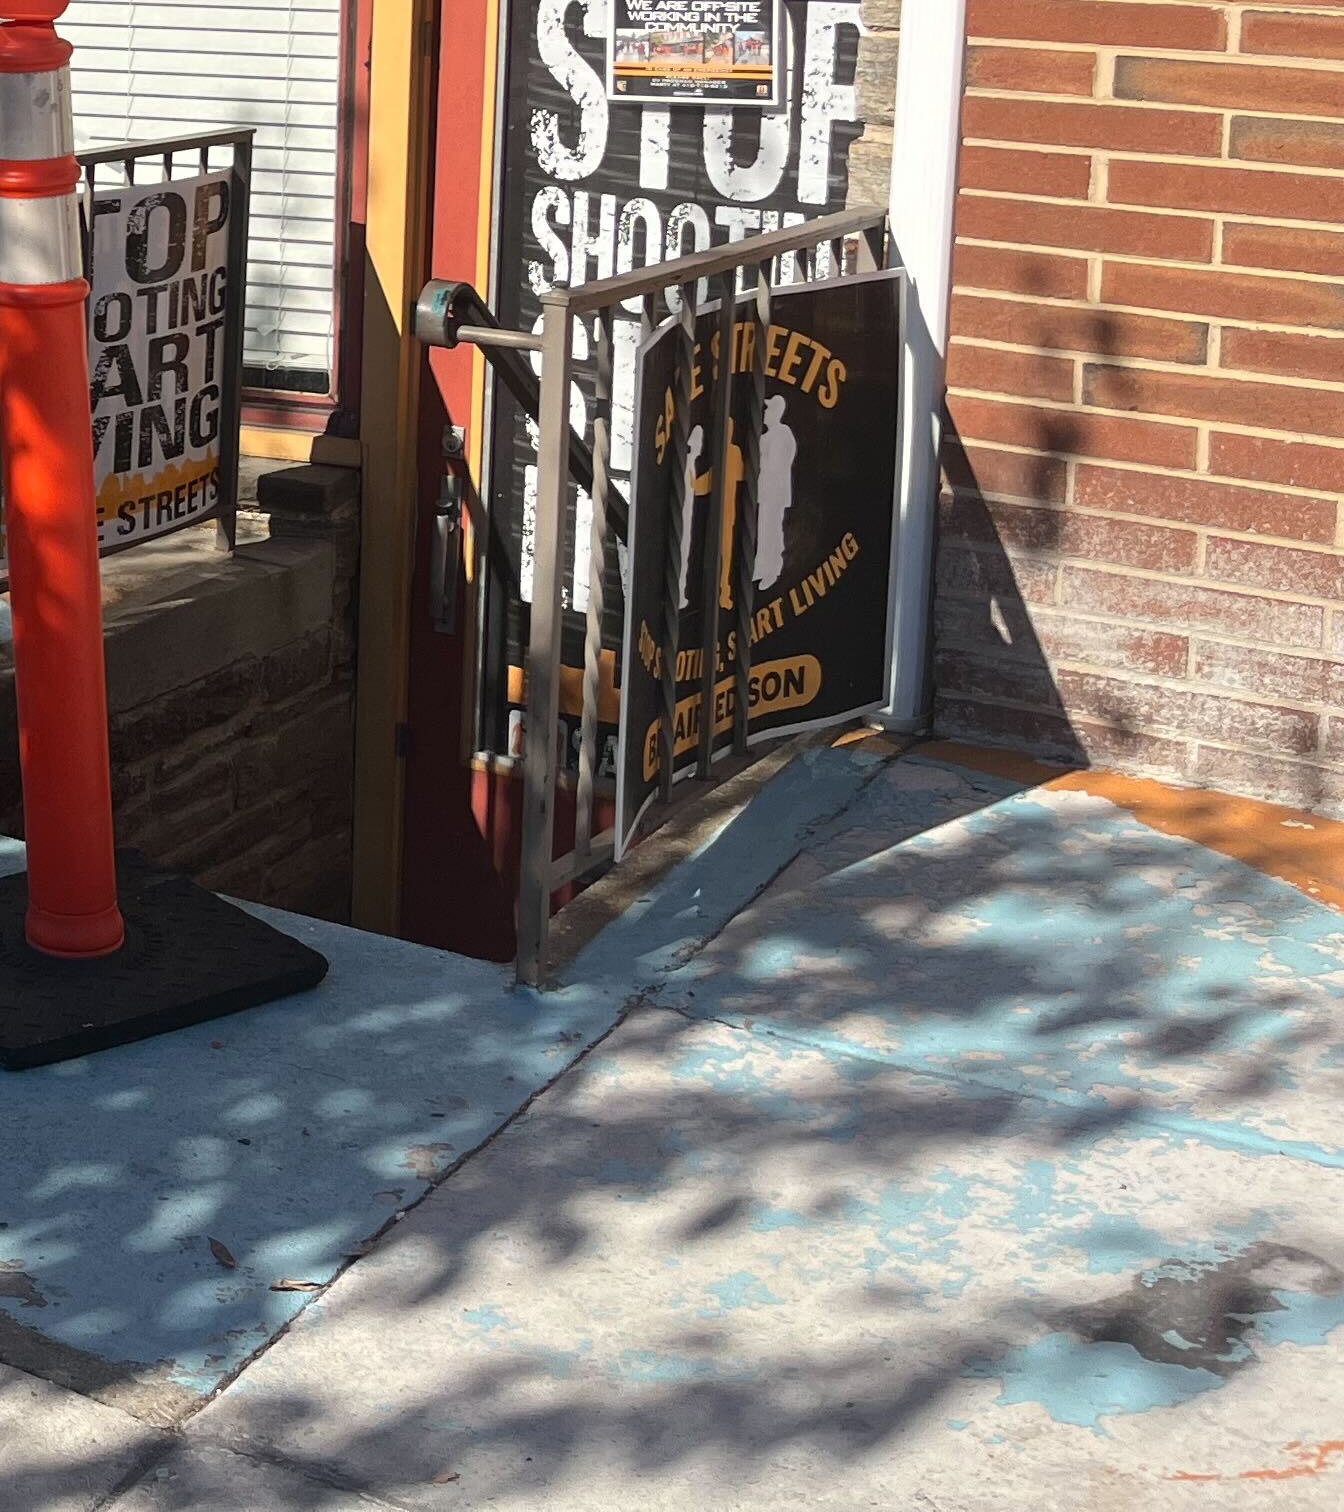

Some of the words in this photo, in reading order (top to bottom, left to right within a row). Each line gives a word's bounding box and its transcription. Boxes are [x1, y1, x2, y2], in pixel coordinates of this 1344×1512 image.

[655, 0, 689, 11] ARE
[627, 11, 700, 22] WORKING
[704, 12, 721, 23] IN
[724, 12, 759, 24] THE
[644, 22, 741, 34] COMMUNITY
[116, 470, 221, 537] STREETS
[727, 596, 785, 662] SART
[789, 531, 860, 617] LIVING
